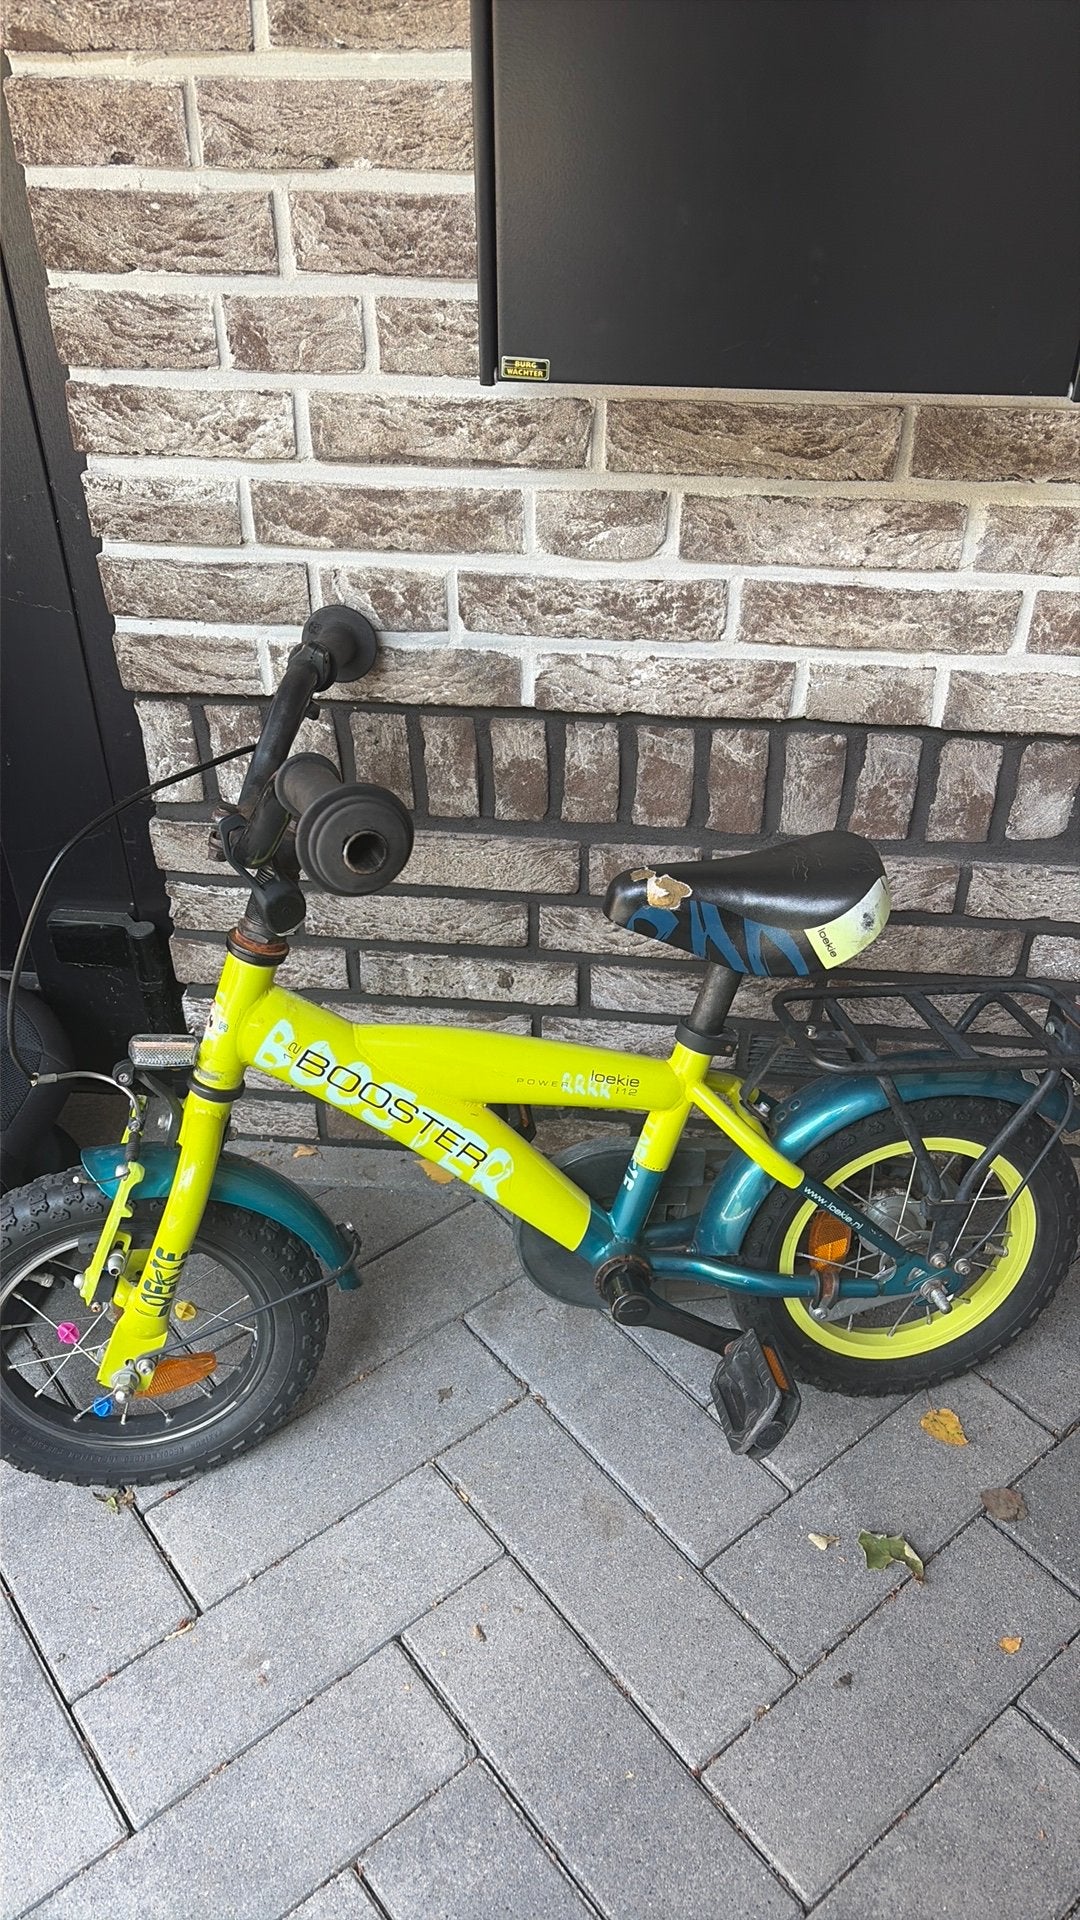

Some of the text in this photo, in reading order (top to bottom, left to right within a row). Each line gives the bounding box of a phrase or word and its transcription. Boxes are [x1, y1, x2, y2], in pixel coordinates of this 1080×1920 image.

[514, 360, 538, 369] BURG
[816, 927, 838, 958] loekie
[516, 1077, 570, 1088] POWER
[590, 1069, 640, 1088] loekie
[296, 1049, 489, 1170] BOOSTER
[803, 1186, 864, 1230] www.loekie.nl
